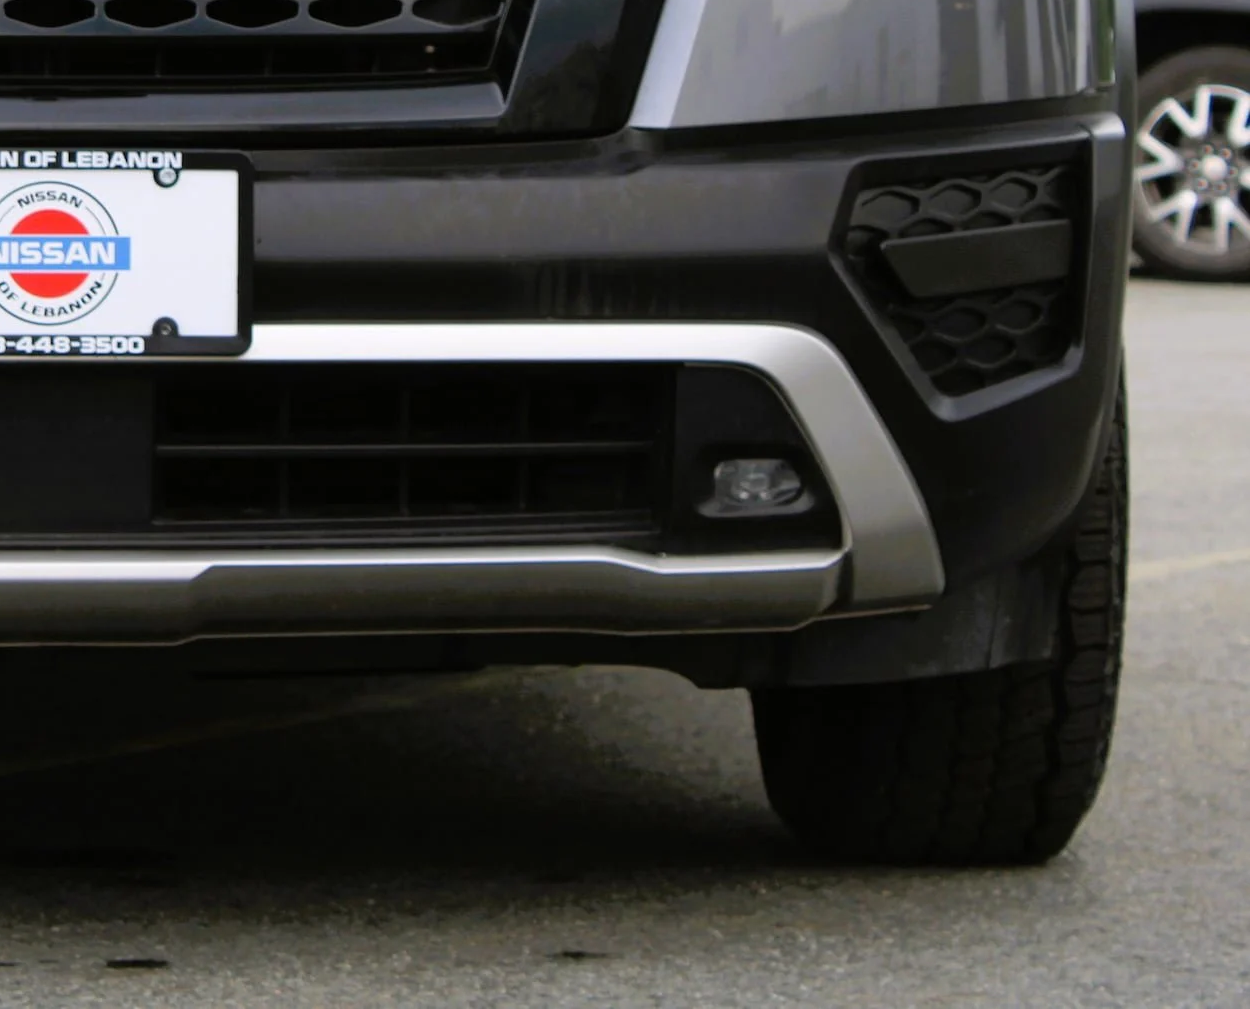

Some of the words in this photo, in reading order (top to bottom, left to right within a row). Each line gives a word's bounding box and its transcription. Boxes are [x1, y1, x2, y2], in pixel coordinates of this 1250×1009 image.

[23, 150, 57, 168] OF
[61, 150, 183, 169] LEBANON
[16, 190, 83, 209] NISSAN
[21, 280, 103, 317] LEBANON
